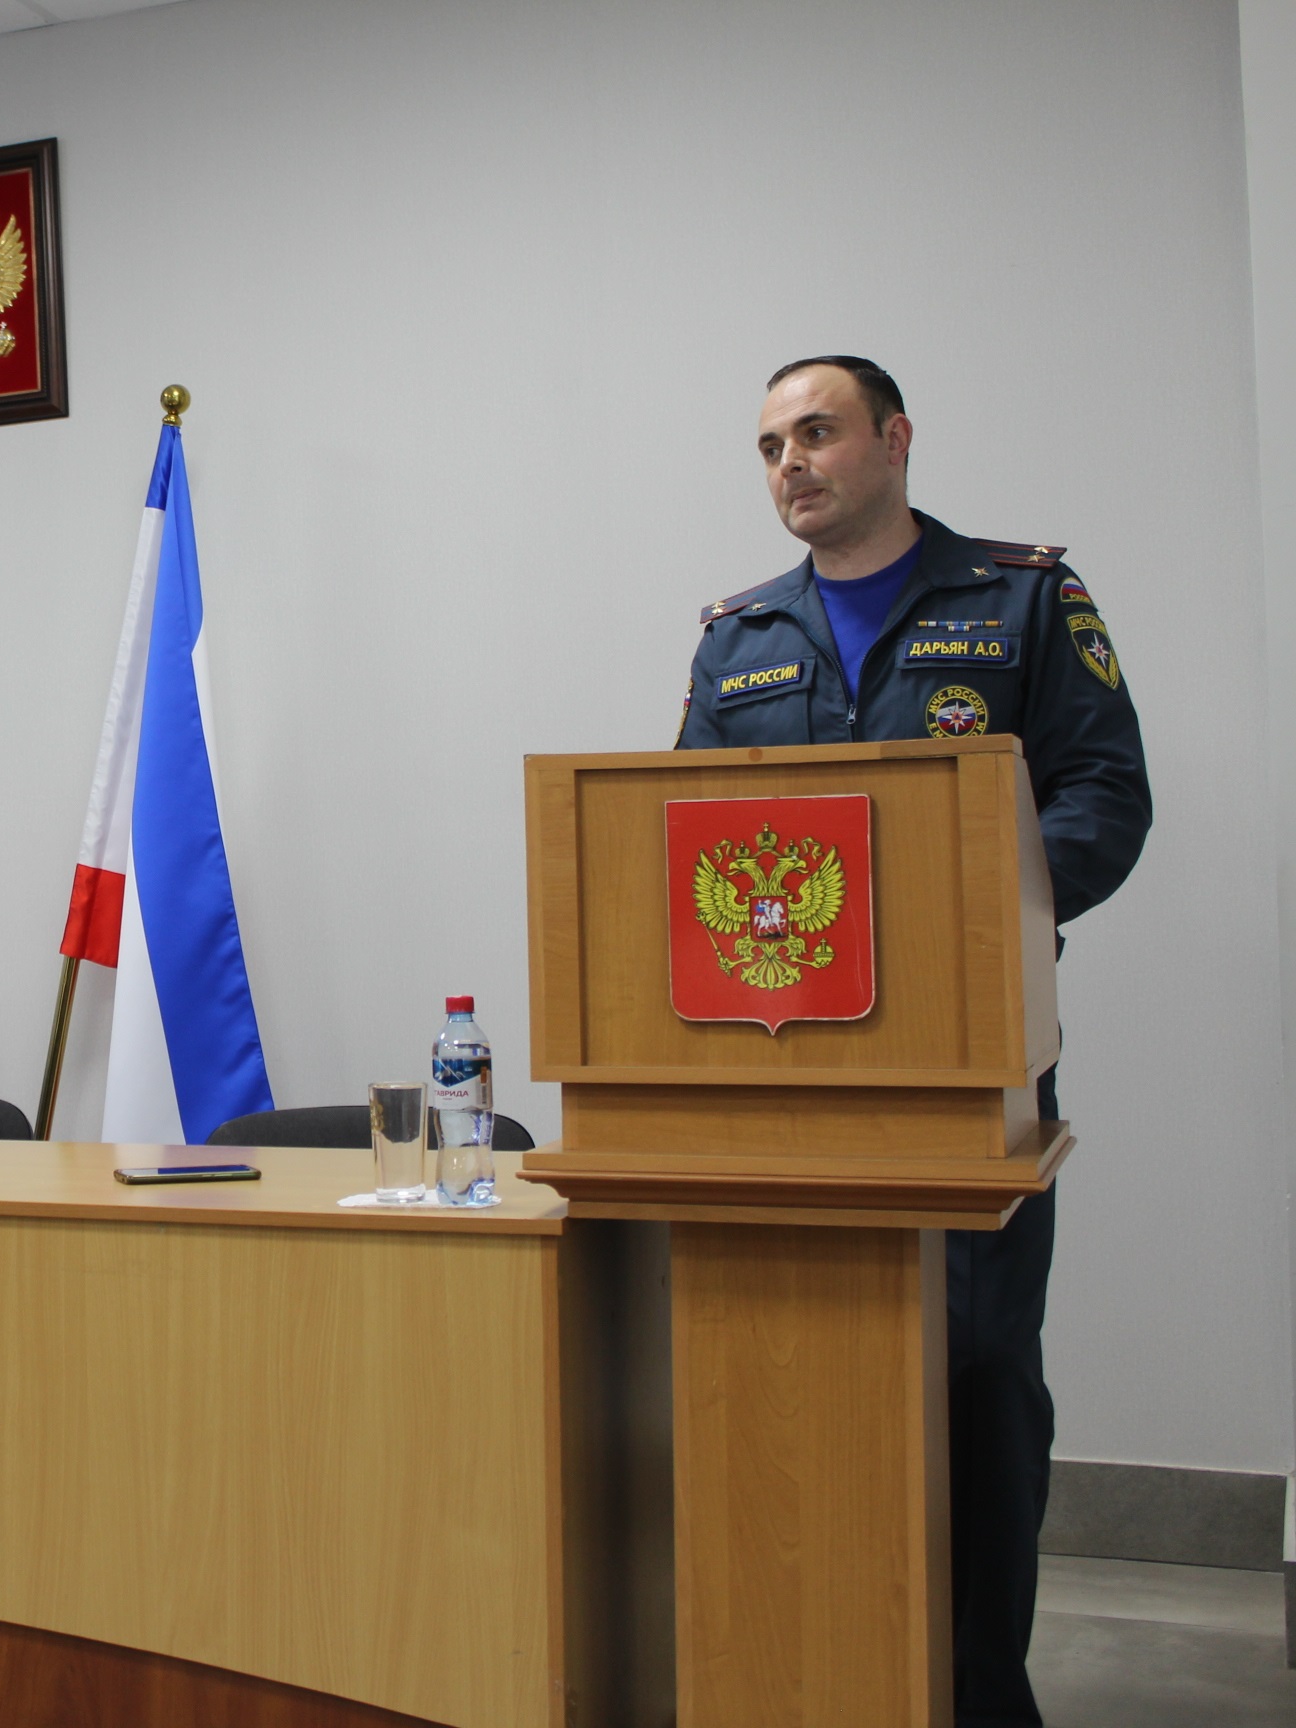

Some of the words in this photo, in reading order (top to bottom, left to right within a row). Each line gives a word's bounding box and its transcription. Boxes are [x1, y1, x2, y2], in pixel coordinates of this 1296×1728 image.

[909, 641, 968, 657] ДАРЬЯН
[974, 641, 1003, 656] А.О.
[721, 675, 746, 693] МЧС
[749, 664, 798, 687] РОССИИ
[929, 692, 946, 714] МЧС
[947, 688, 985, 715] РОССИИ
